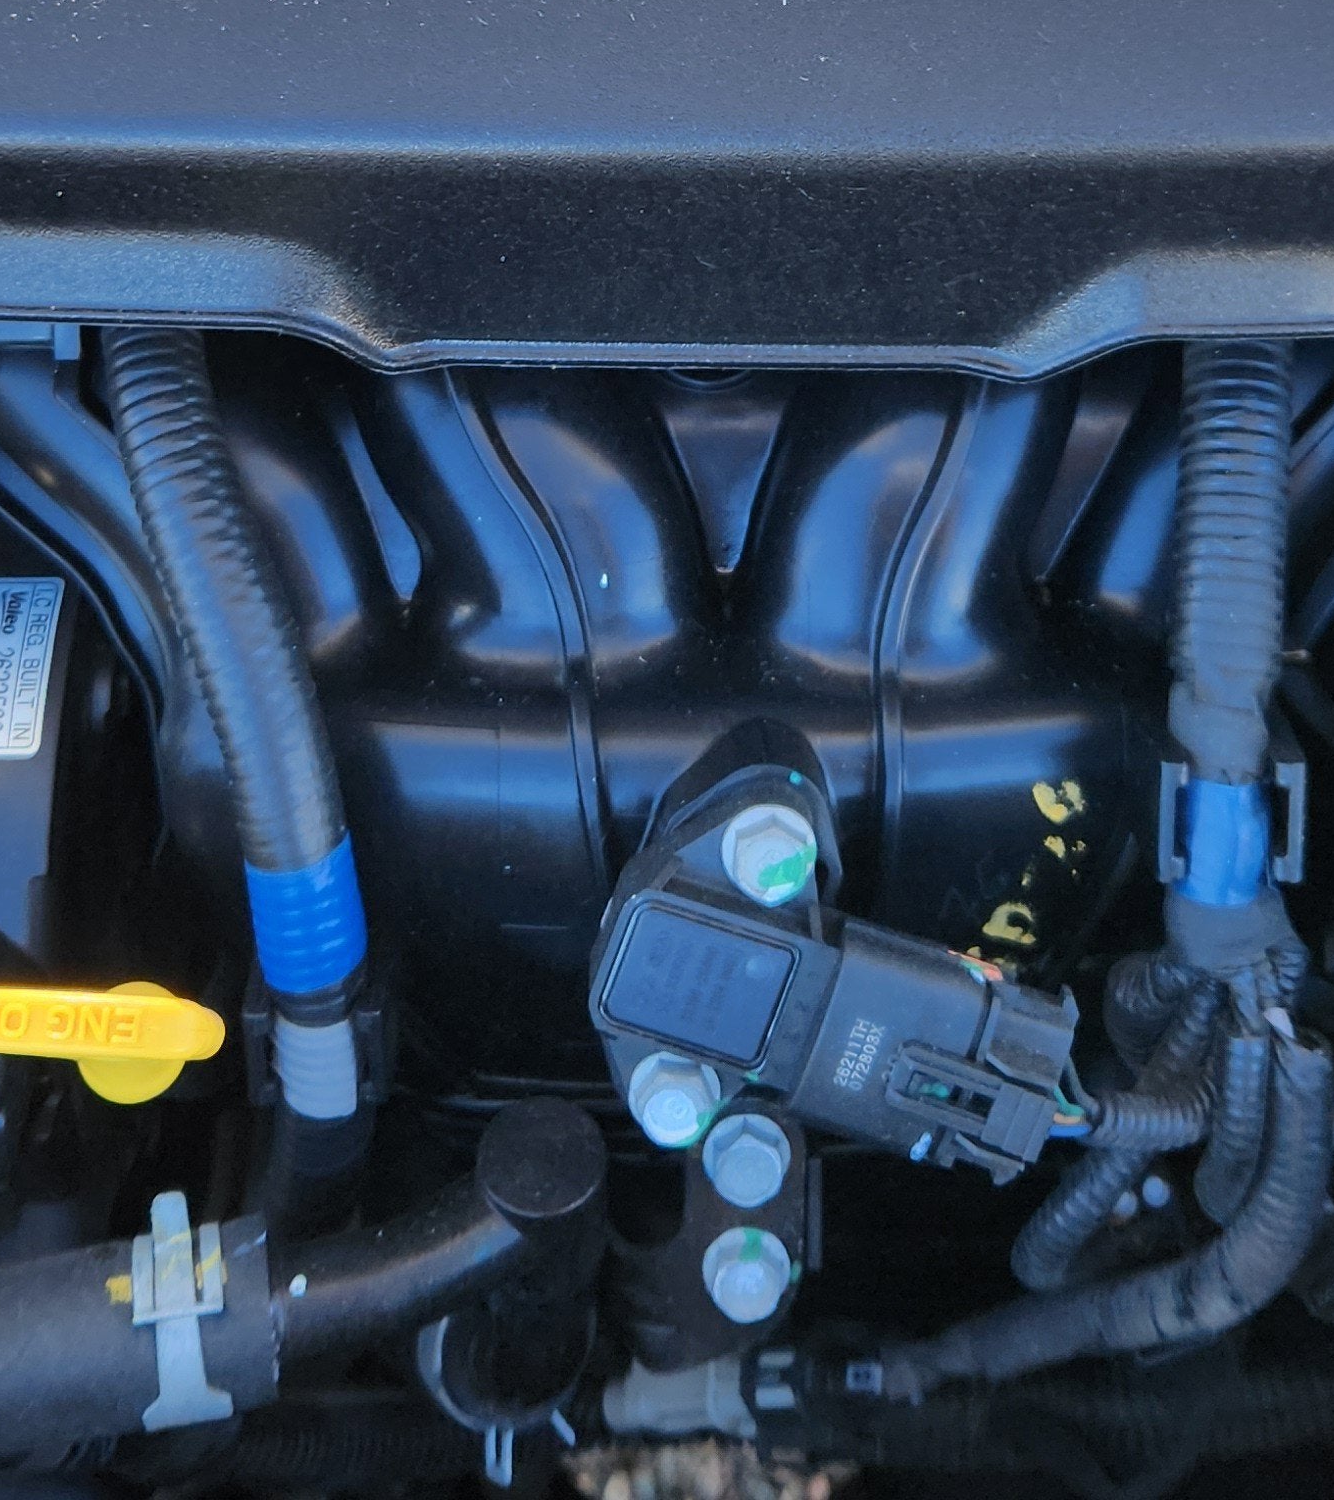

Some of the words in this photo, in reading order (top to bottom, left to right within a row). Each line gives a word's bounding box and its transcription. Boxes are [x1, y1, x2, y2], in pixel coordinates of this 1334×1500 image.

[25, 613, 49, 651] REG.
[17, 658, 42, 708] BUILT
[12, 722, 32, 741] IN
[46, 1004, 145, 1043] ENG
[833, 1018, 870, 1087] 26211TH
[848, 1023, 886, 1092] 072803X
